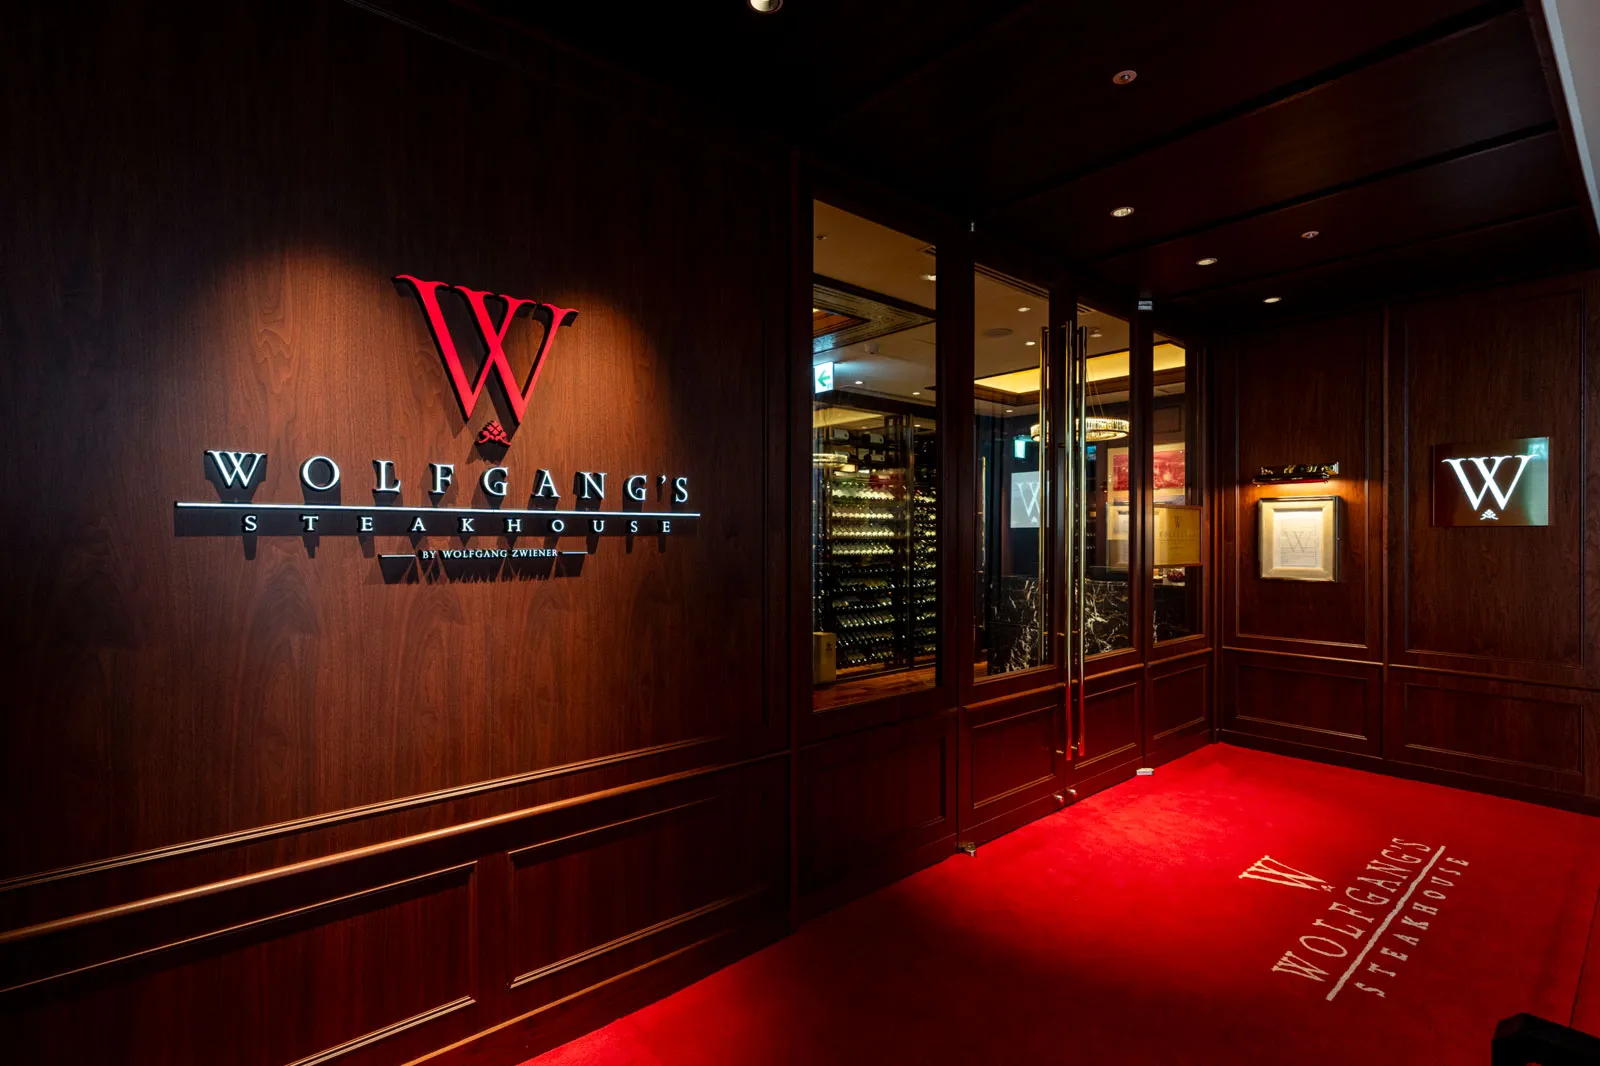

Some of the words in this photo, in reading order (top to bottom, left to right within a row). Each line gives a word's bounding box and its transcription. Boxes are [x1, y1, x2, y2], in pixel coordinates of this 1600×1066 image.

[394, 274, 580, 424] W
[205, 448, 689, 503] WOLFGANG'S
[1441, 453, 1540, 511] W
[243, 513, 671, 533] STEAKHOUSE
[422, 550, 438, 559] BY
[442, 549, 508, 559] WOLFGANG
[511, 548, 558, 558] ZWIENER
[1238, 854, 1327, 891] W
[1271, 837, 1431, 982] WOLFGANG'S
[1354, 857, 1469, 998] STEAKHOUSE
